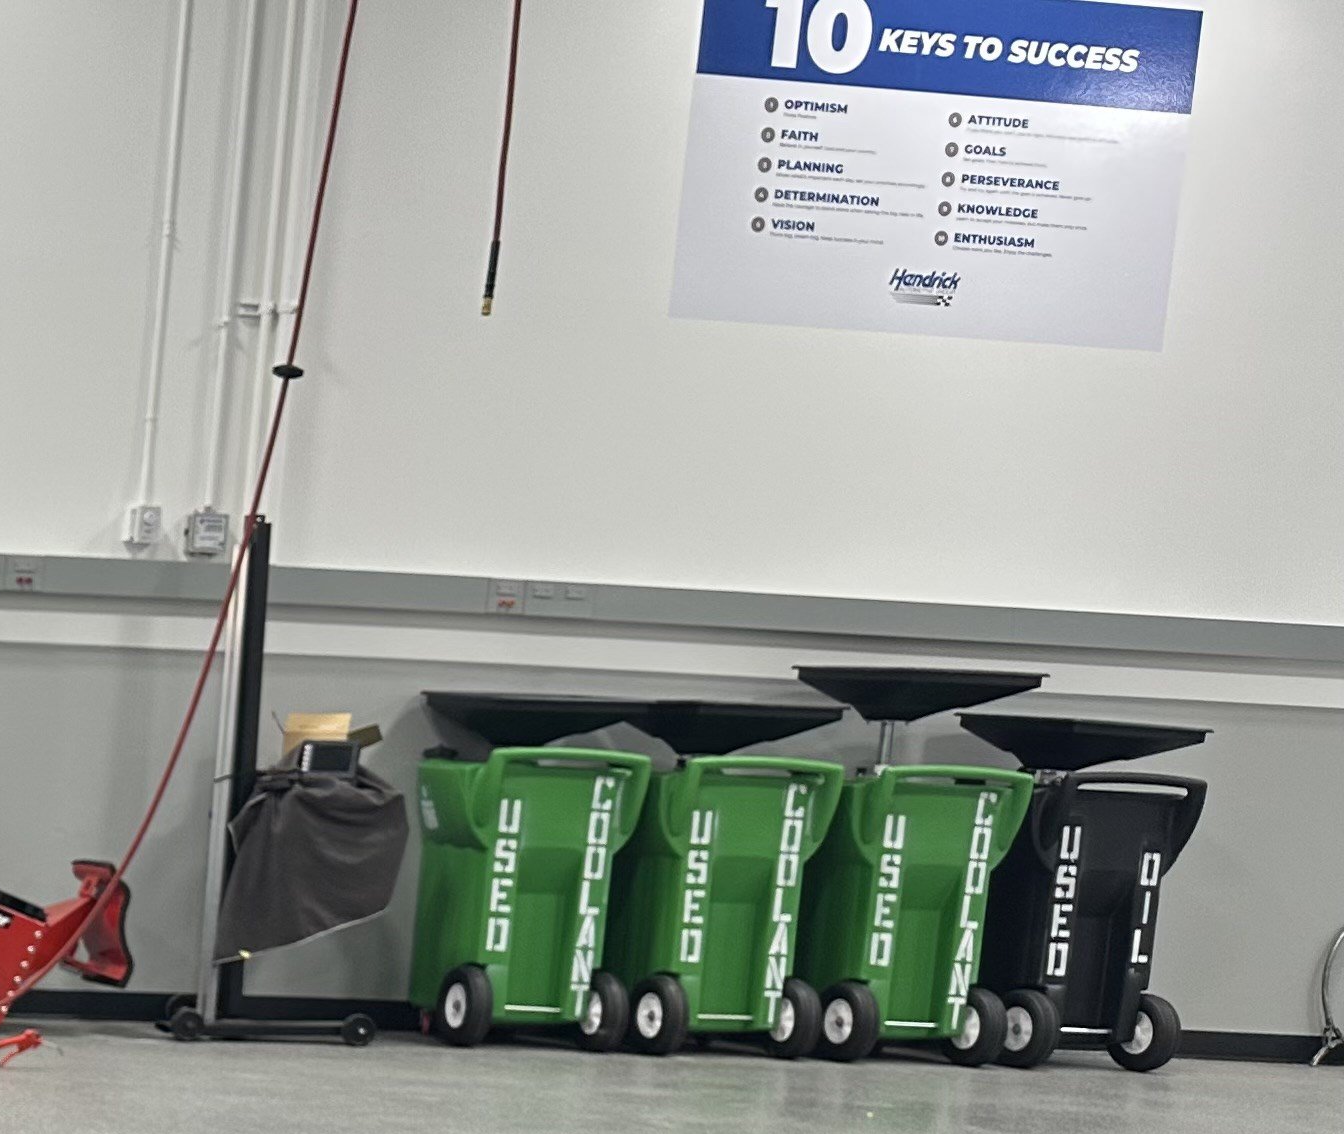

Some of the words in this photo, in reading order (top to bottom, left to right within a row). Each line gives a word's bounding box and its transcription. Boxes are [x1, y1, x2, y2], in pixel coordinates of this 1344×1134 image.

[765, 0, 873, 75] 10
[878, 28, 957, 58] KEYS
[963, 35, 1003, 61] TO
[1007, 39, 1141, 73] SUCCESS
[784, 99, 849, 114] OPTIMISM
[967, 114, 1030, 129] ATTITUDE
[780, 129, 819, 142] FAITH
[964, 144, 1007, 157] GOALS
[777, 159, 844, 174] PLANNING
[961, 174, 1060, 191] PERSEVERANCE
[774, 189, 880, 207] DETERMINATION
[957, 203, 1039, 219] KNOWLEDGE
[771, 218, 815, 232] VISION
[953, 232, 1035, 248] ENTHUSIASM
[486, 798, 521, 952] USED
[570, 776, 615, 1017] COOLANT
[680, 810, 713, 963] USED
[764, 783, 807, 1024] COOLANT
[1046, 825, 1082, 977] USED
[1130, 852, 1161, 964] OIL
[869, 814, 906, 967] USED
[947, 792, 998, 1030] COOLANT
